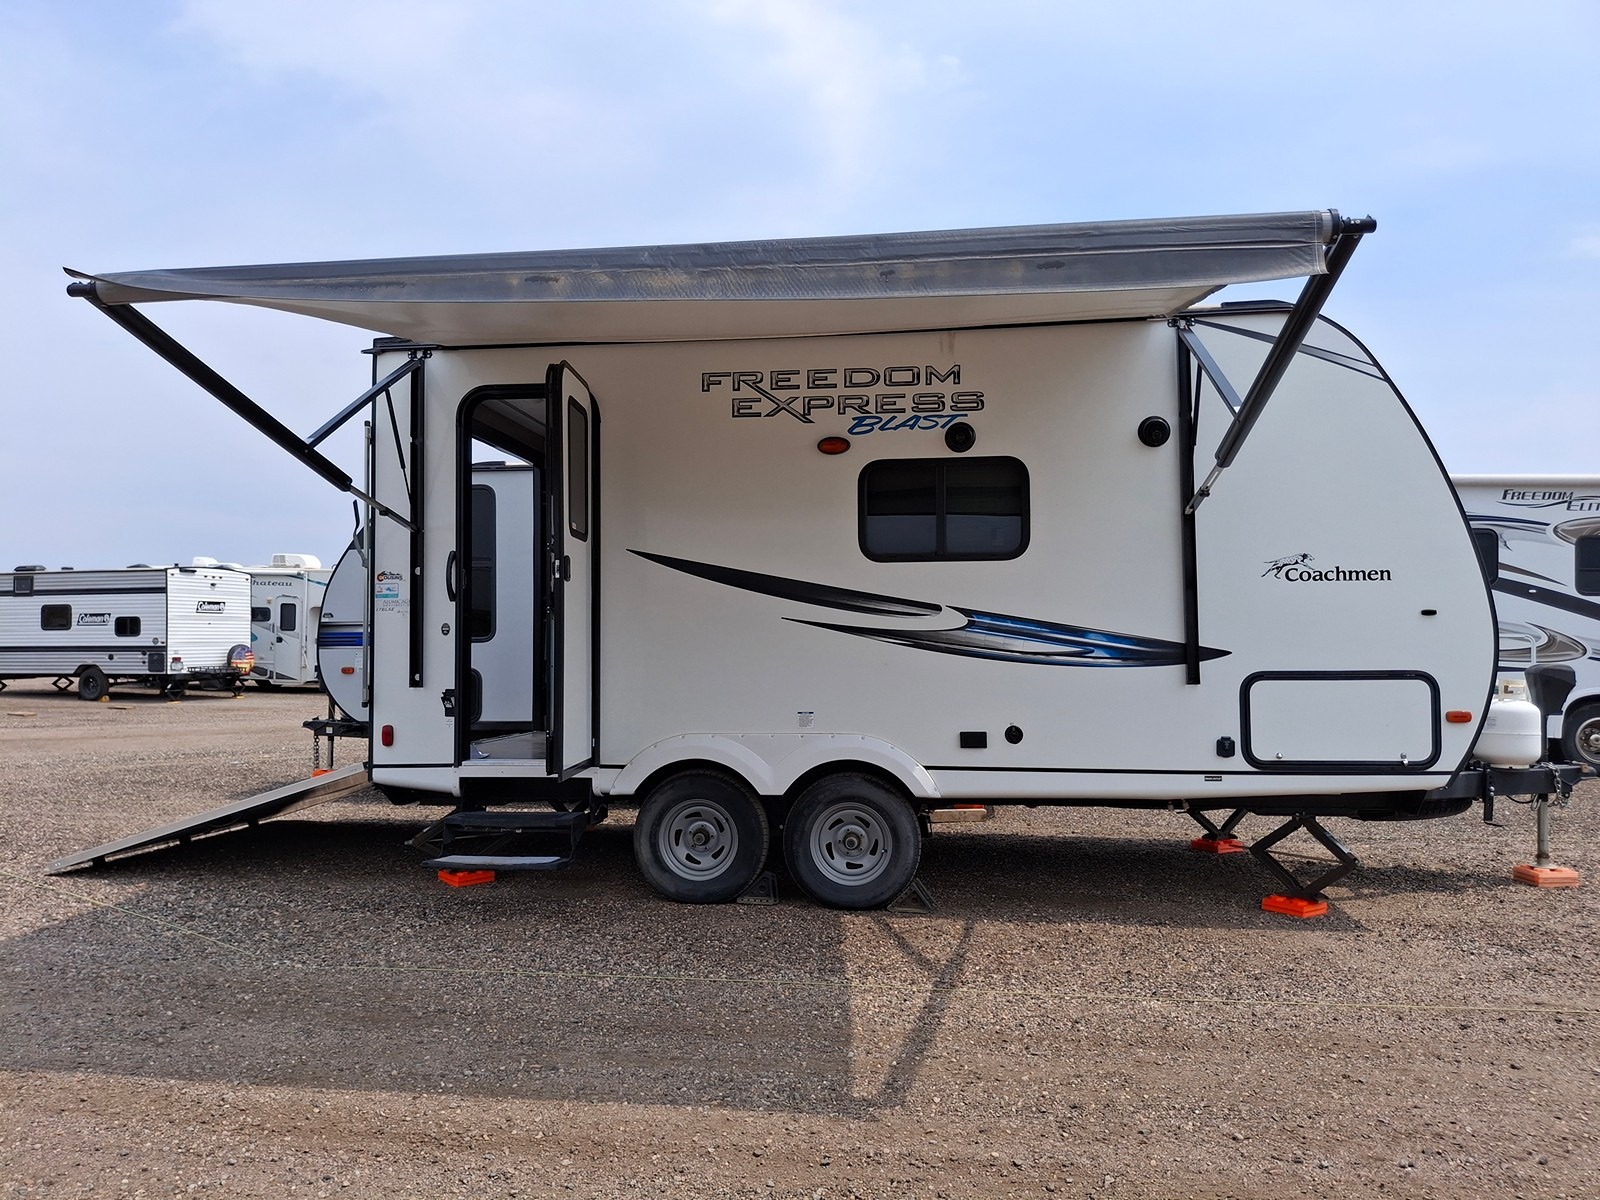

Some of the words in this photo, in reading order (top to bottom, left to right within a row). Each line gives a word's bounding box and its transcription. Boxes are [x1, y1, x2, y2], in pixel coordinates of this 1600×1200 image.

[701, 364, 961, 392] FREEDOM
[731, 391, 985, 424] EXPRESS
[847, 413, 968, 435] BLAST
[1502, 488, 1574, 501] FREEDOM
[1566, 500, 1600, 512] ELIT
[1284, 565, 1392, 582] Coachmen
[252, 579, 293, 587] hateau
[196, 601, 219, 612] Coleman
[78, 613, 105, 625] Coleman
